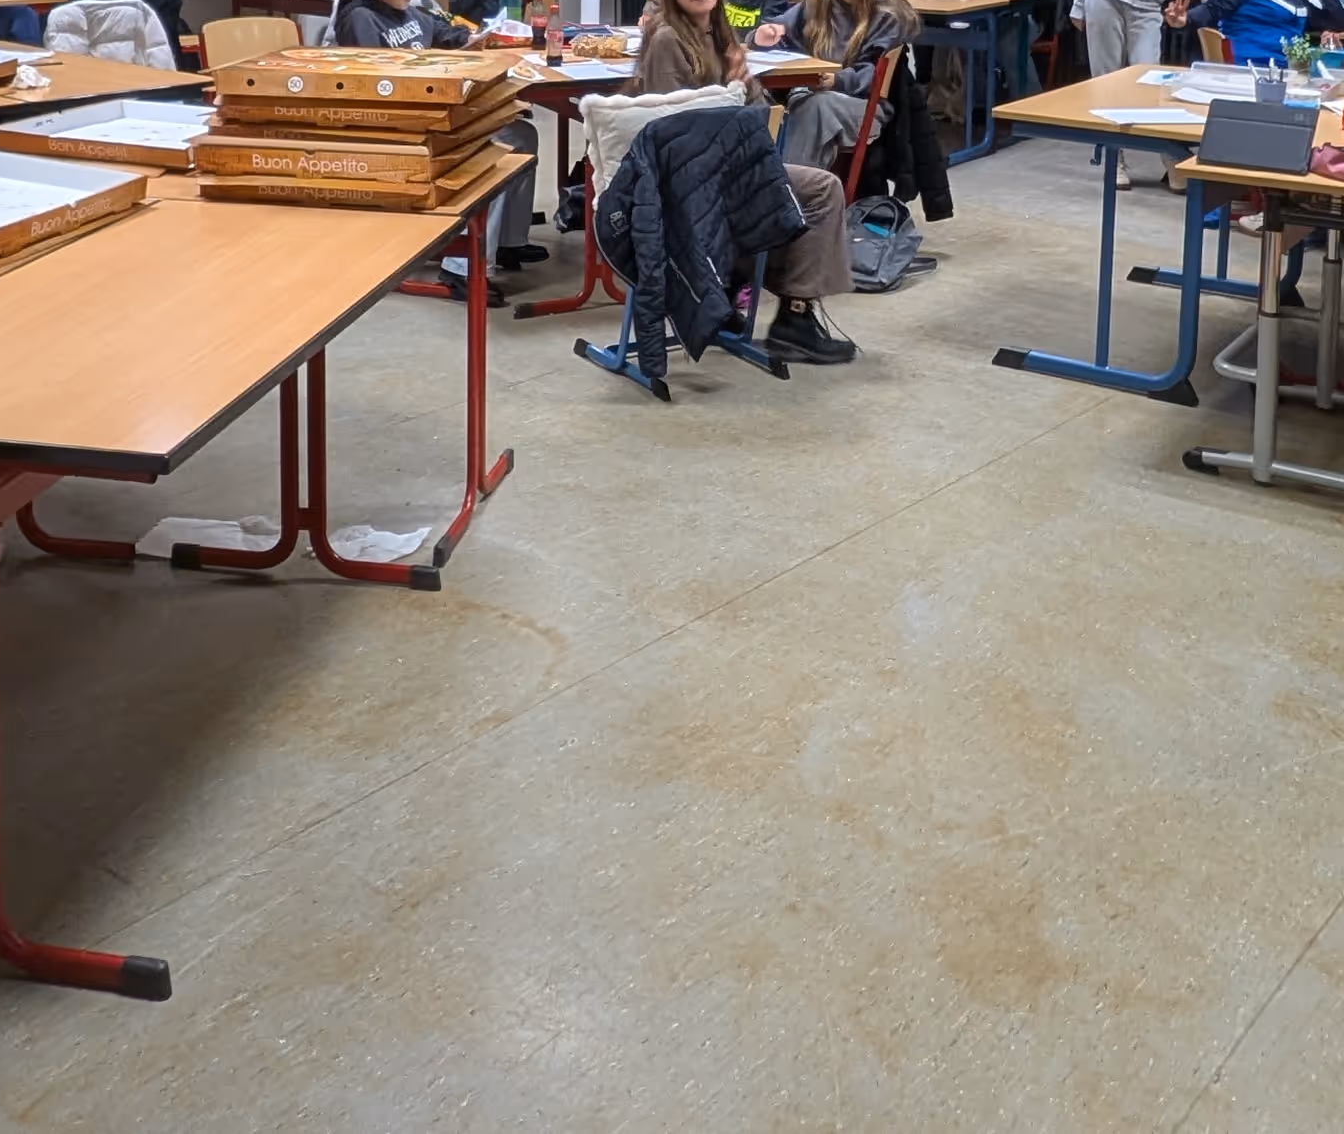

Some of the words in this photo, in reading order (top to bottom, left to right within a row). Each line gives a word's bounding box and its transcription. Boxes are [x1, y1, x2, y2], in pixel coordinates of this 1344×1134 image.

[48, 139, 75, 153] Bon
[77, 141, 128, 159] Appetit
[252, 153, 293, 170] Buon
[297, 156, 369, 174] Appetito
[30, 216, 62, 237] Buon
